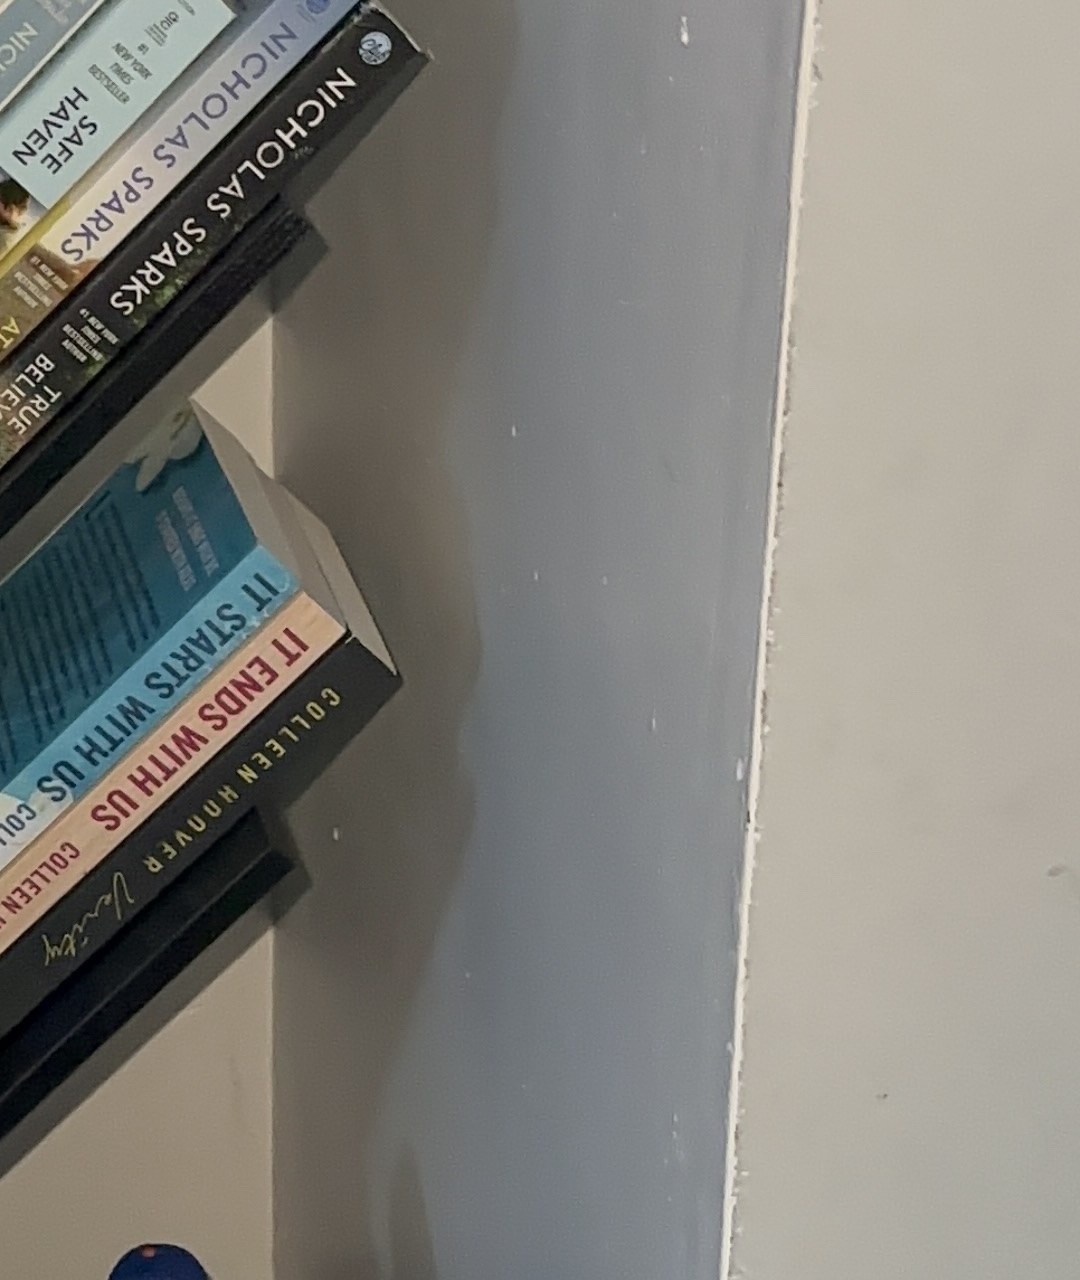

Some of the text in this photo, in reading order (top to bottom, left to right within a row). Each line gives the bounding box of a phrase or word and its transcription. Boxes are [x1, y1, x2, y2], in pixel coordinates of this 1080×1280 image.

[88, 64, 130, 104] BESTSELLER
[112, 42, 152, 80] NEW YORK
[11, 85, 90, 167] HAVEN
[40, 114, 98, 176] SAFE
[60, 21, 299, 264] NICHOLAS SPARKS
[109, 67, 358, 317] NICHOLAS SPARKS
[7, 385, 62, 435] TRUE
[37, 572, 281, 803] IT STARTS WITH US
[90, 626, 310, 831] IT ENDS WITH US
[142, 687, 342, 874] COLLEEN HOOVER
[0, 841, 81, 915] COLLEEN
[41, 871, 135, 967] Verity
